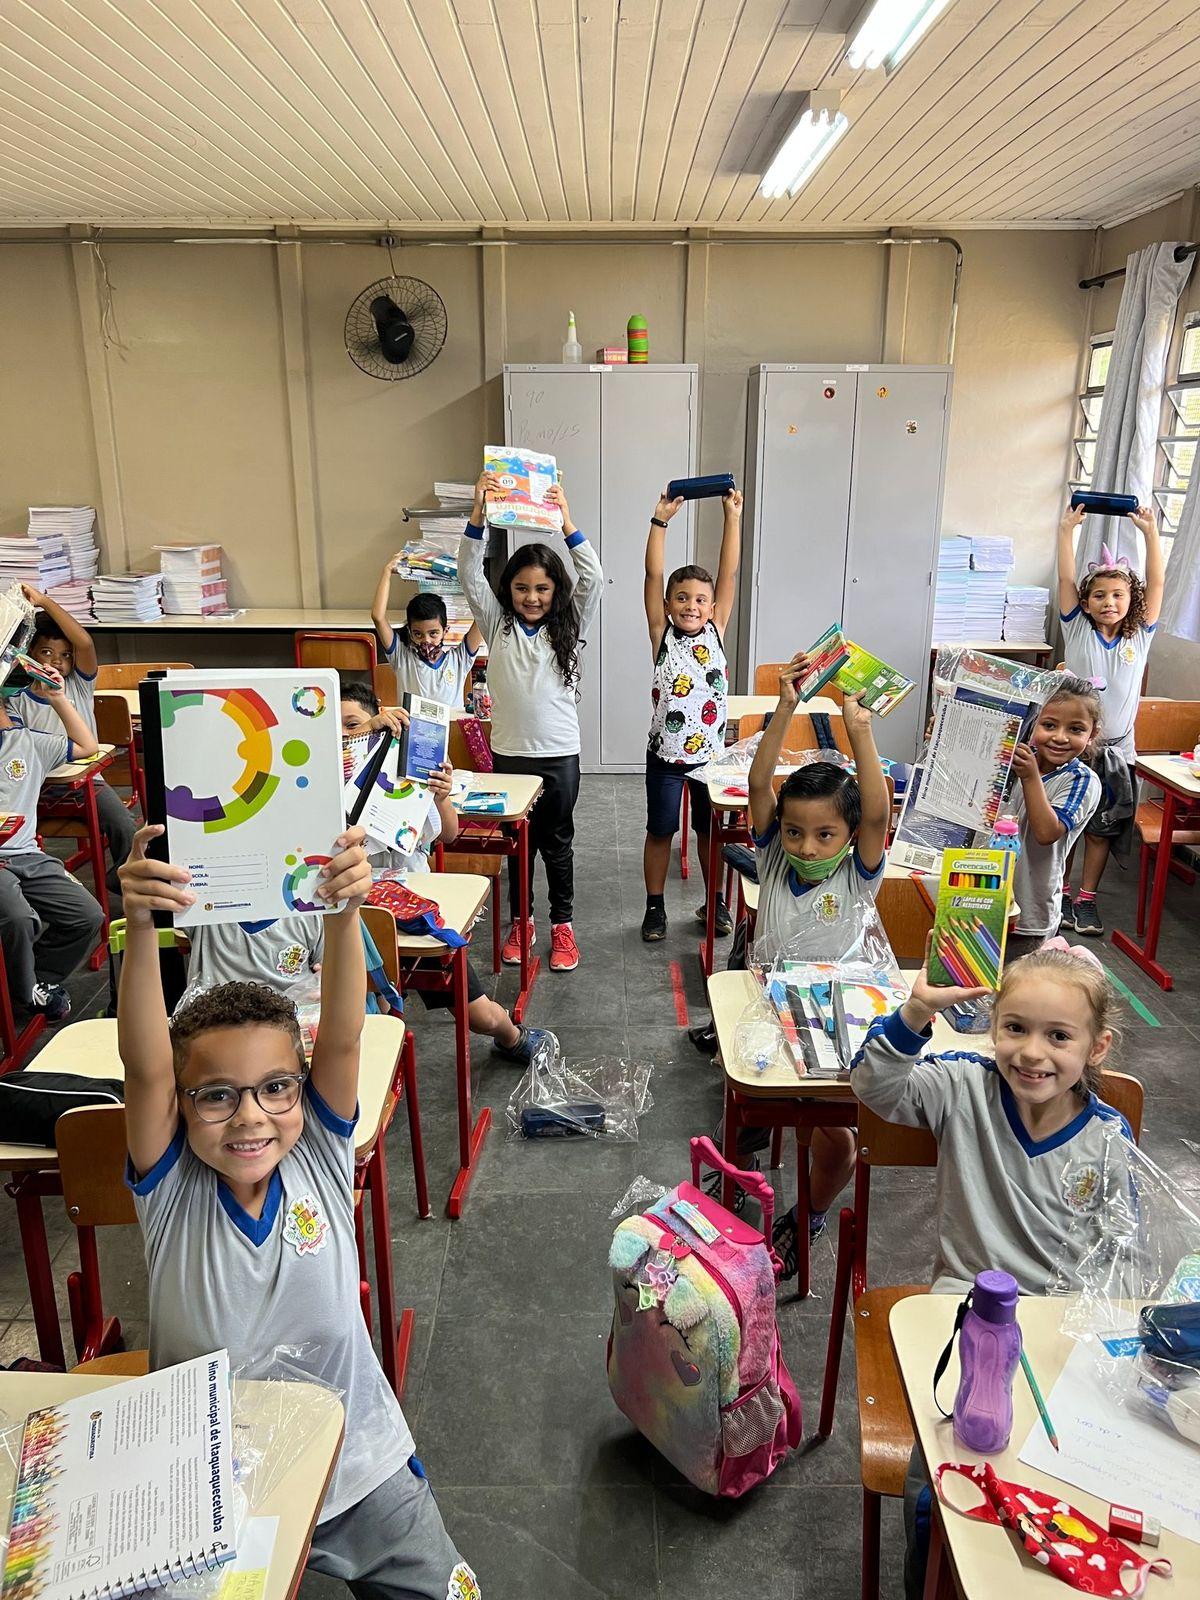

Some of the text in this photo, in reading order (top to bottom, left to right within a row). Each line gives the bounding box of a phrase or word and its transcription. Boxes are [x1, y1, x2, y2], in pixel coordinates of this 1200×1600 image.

[953, 861, 997, 870] Greencastle
[952, 896, 962, 907] 12
[207, 1360, 225, 1533] Hino municipal de Itaquaquecetuba
